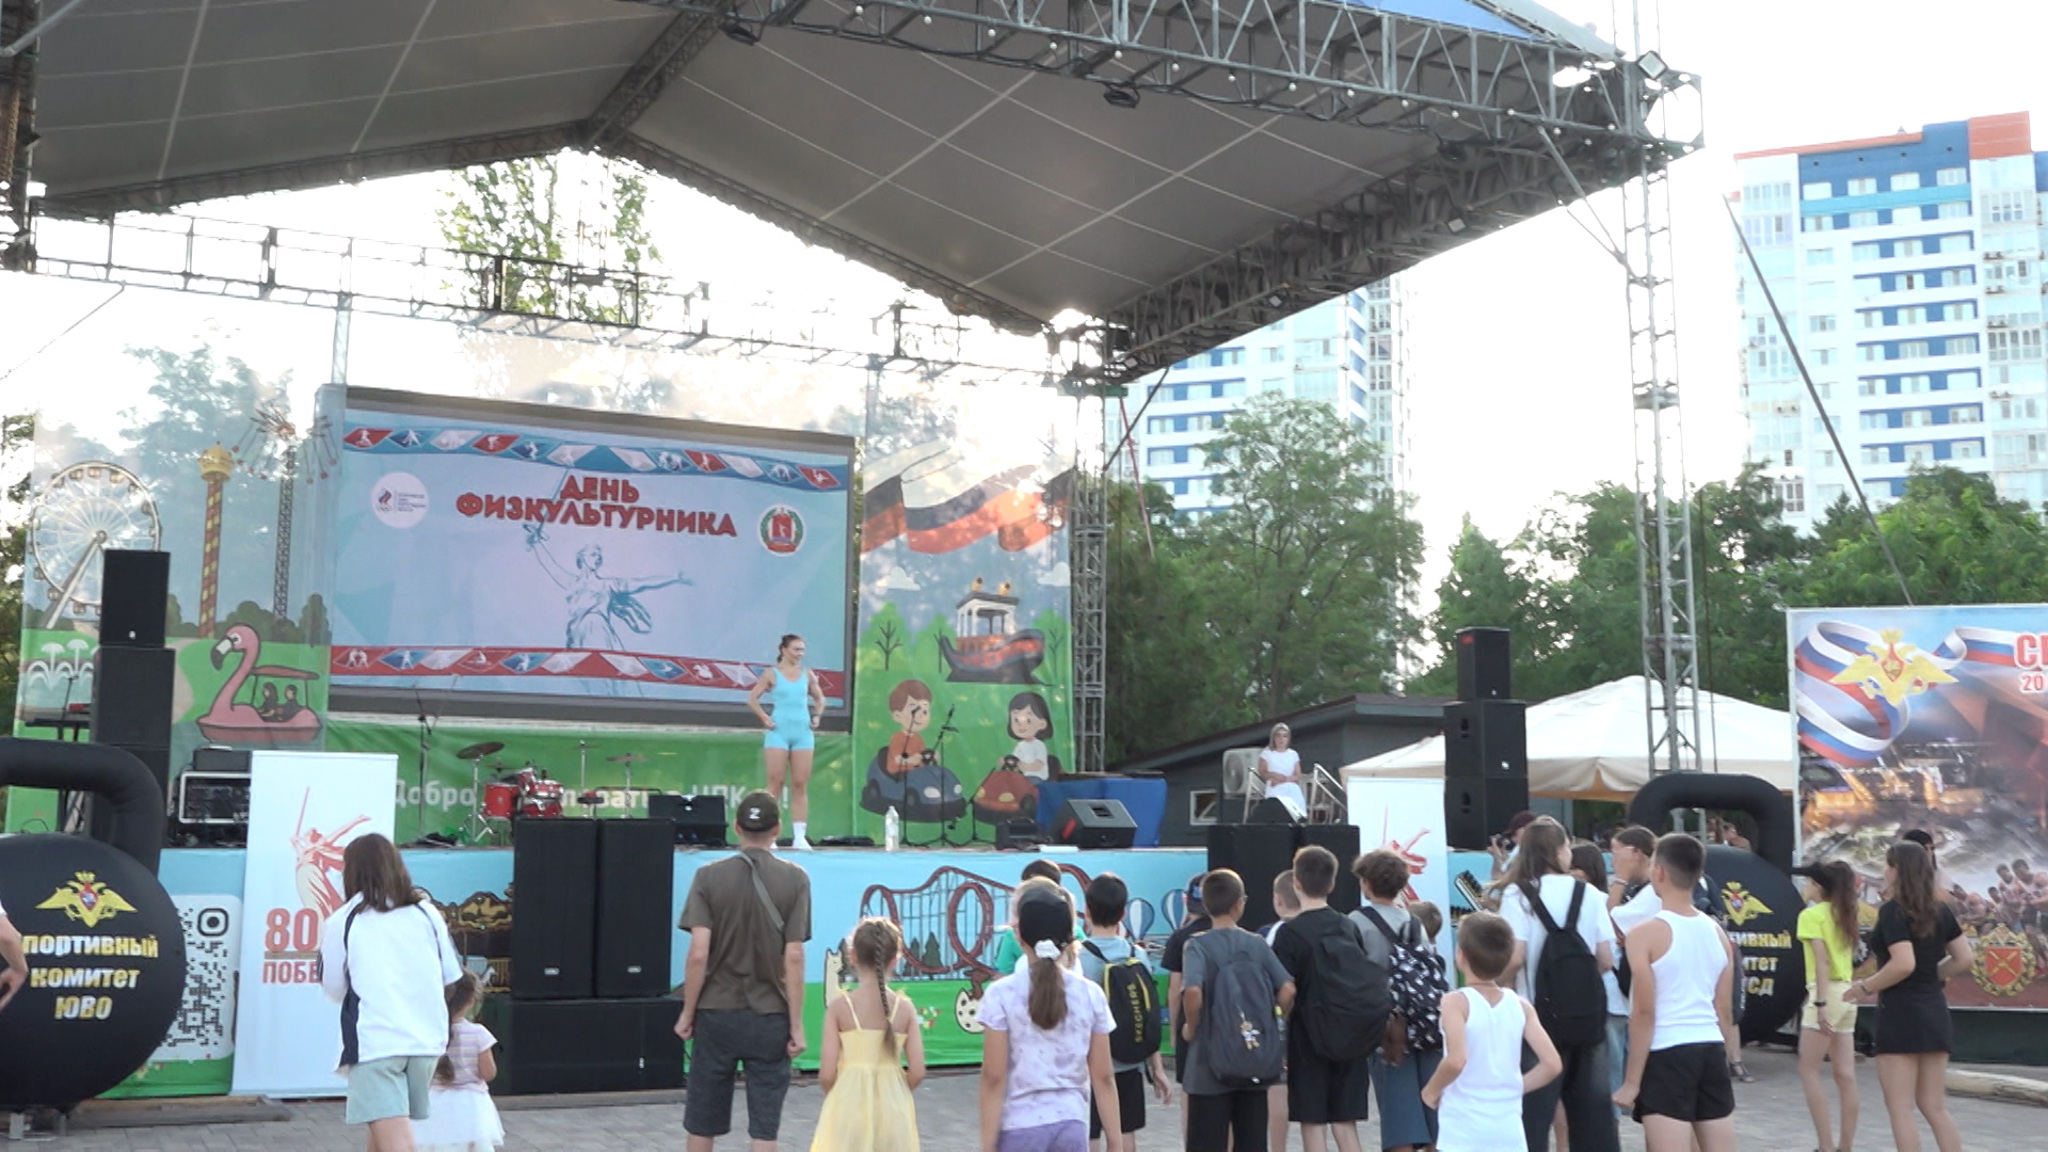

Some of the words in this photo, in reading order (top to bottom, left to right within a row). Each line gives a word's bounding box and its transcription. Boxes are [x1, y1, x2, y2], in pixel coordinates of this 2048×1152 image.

[560, 475, 640, 503] ДЕНЬ
[456, 492, 738, 537] ФИЗКУЛЬТУРНИКА
[265, 908, 319, 952] 80
[22, 933, 159, 958] портивный
[30, 967, 141, 989] комитет
[262, 961, 320, 984] ПОБЕ
[54, 995, 113, 1020] ЮВО
